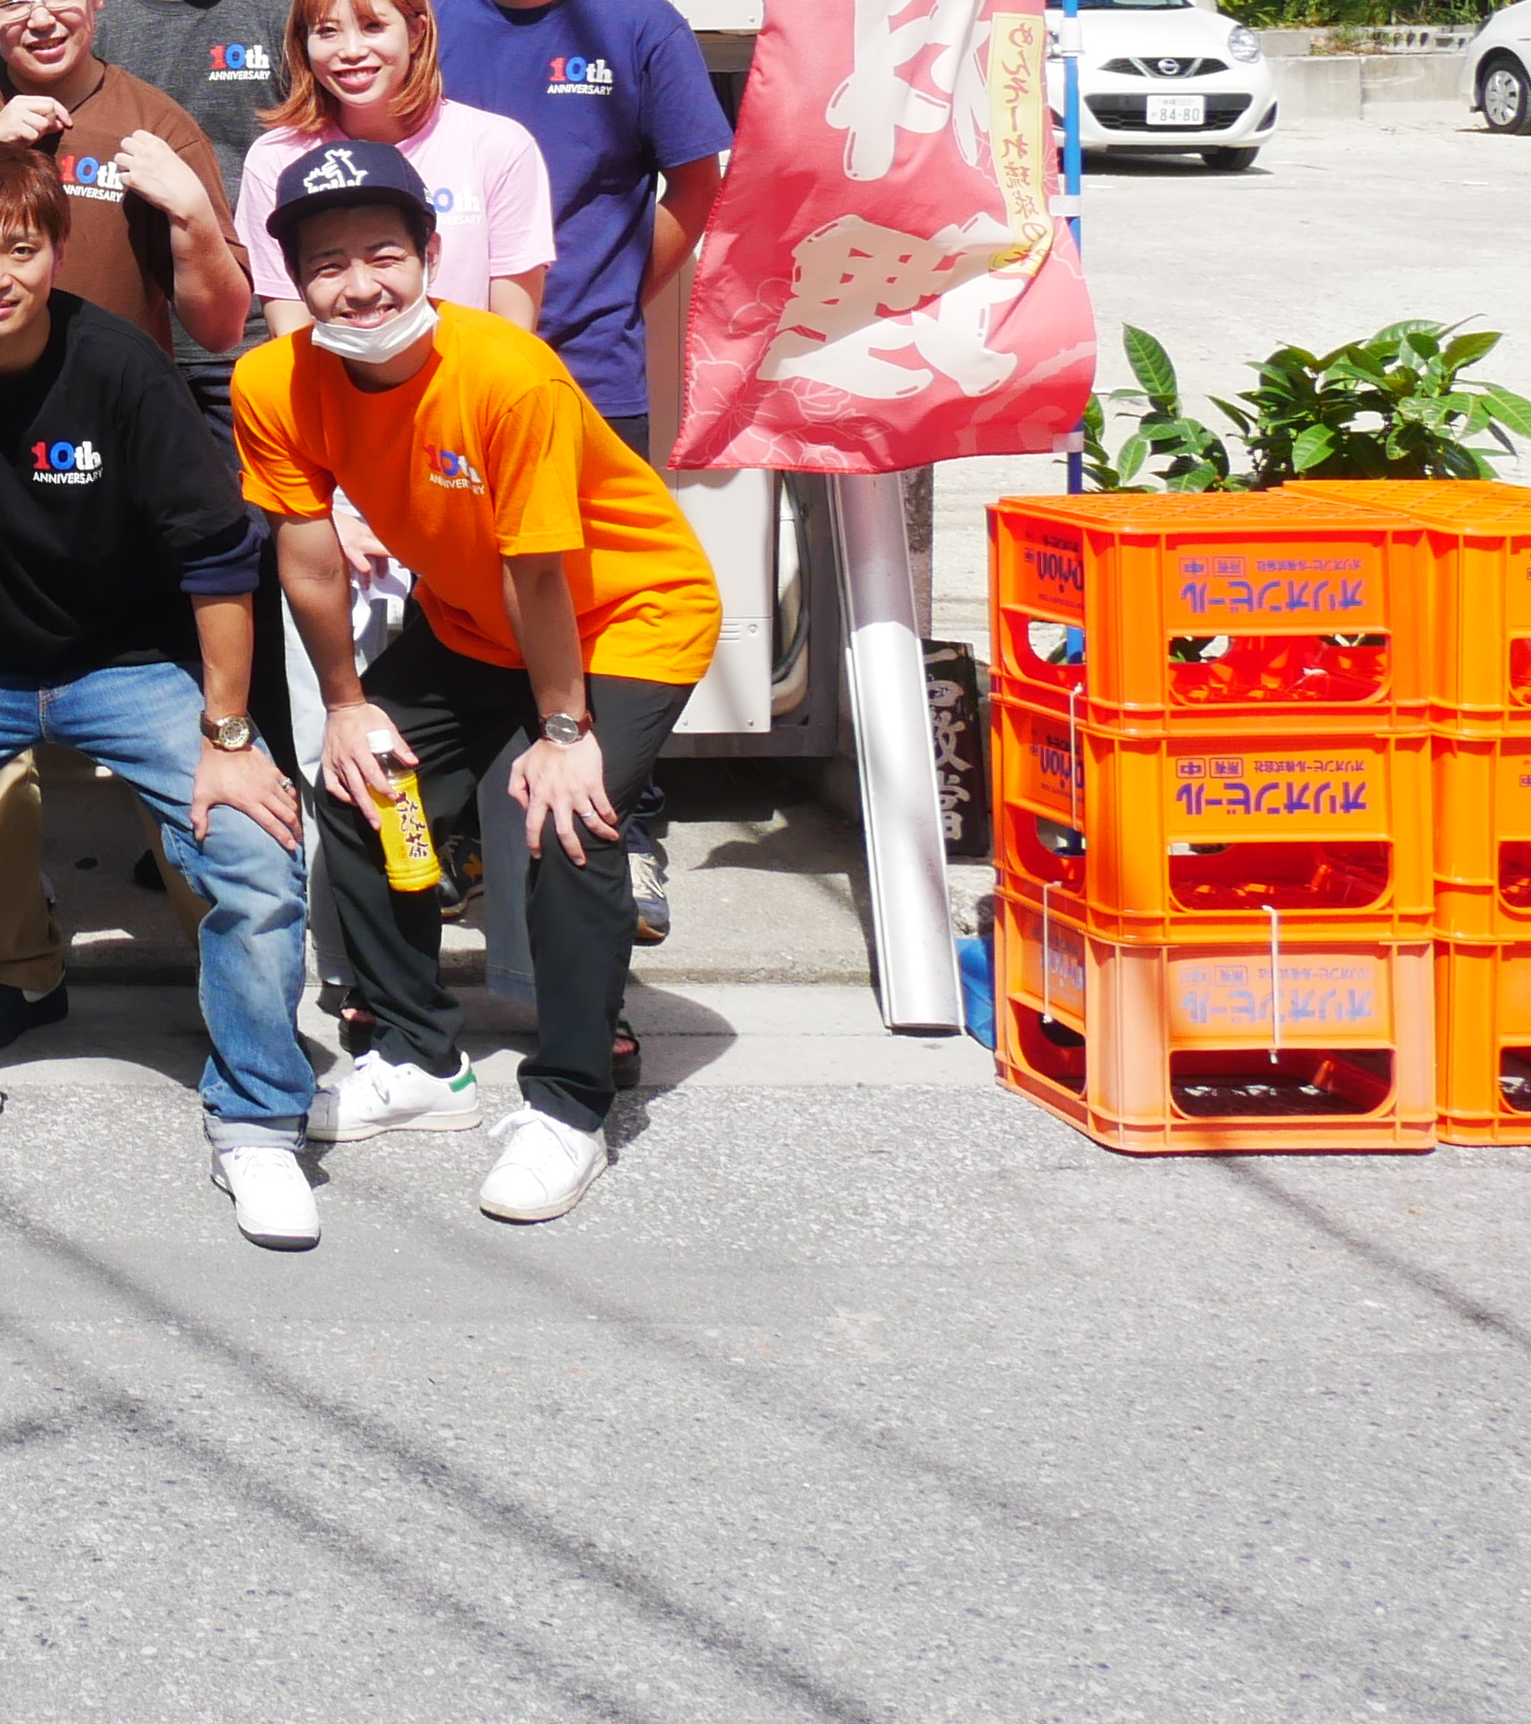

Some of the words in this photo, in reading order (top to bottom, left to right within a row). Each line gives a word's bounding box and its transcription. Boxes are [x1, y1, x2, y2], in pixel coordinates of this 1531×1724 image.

[209, 43, 270, 69] 10th
[209, 70, 270, 81] ANNIVERSARY
[549, 56, 613, 83] 10th
[547, 84, 613, 95] ANNIVERSARY
[61, 155, 124, 189] 10th
[433, 187, 481, 213] 0th
[31, 441, 102, 471] 10th
[33, 468, 104, 485] ANNIVERSARY
[1180, 579, 1365, 614] オリオンビール
[1253, 759, 1366, 773] オリオンビール株式会社
[1175, 780, 1368, 816] オリオンビール
